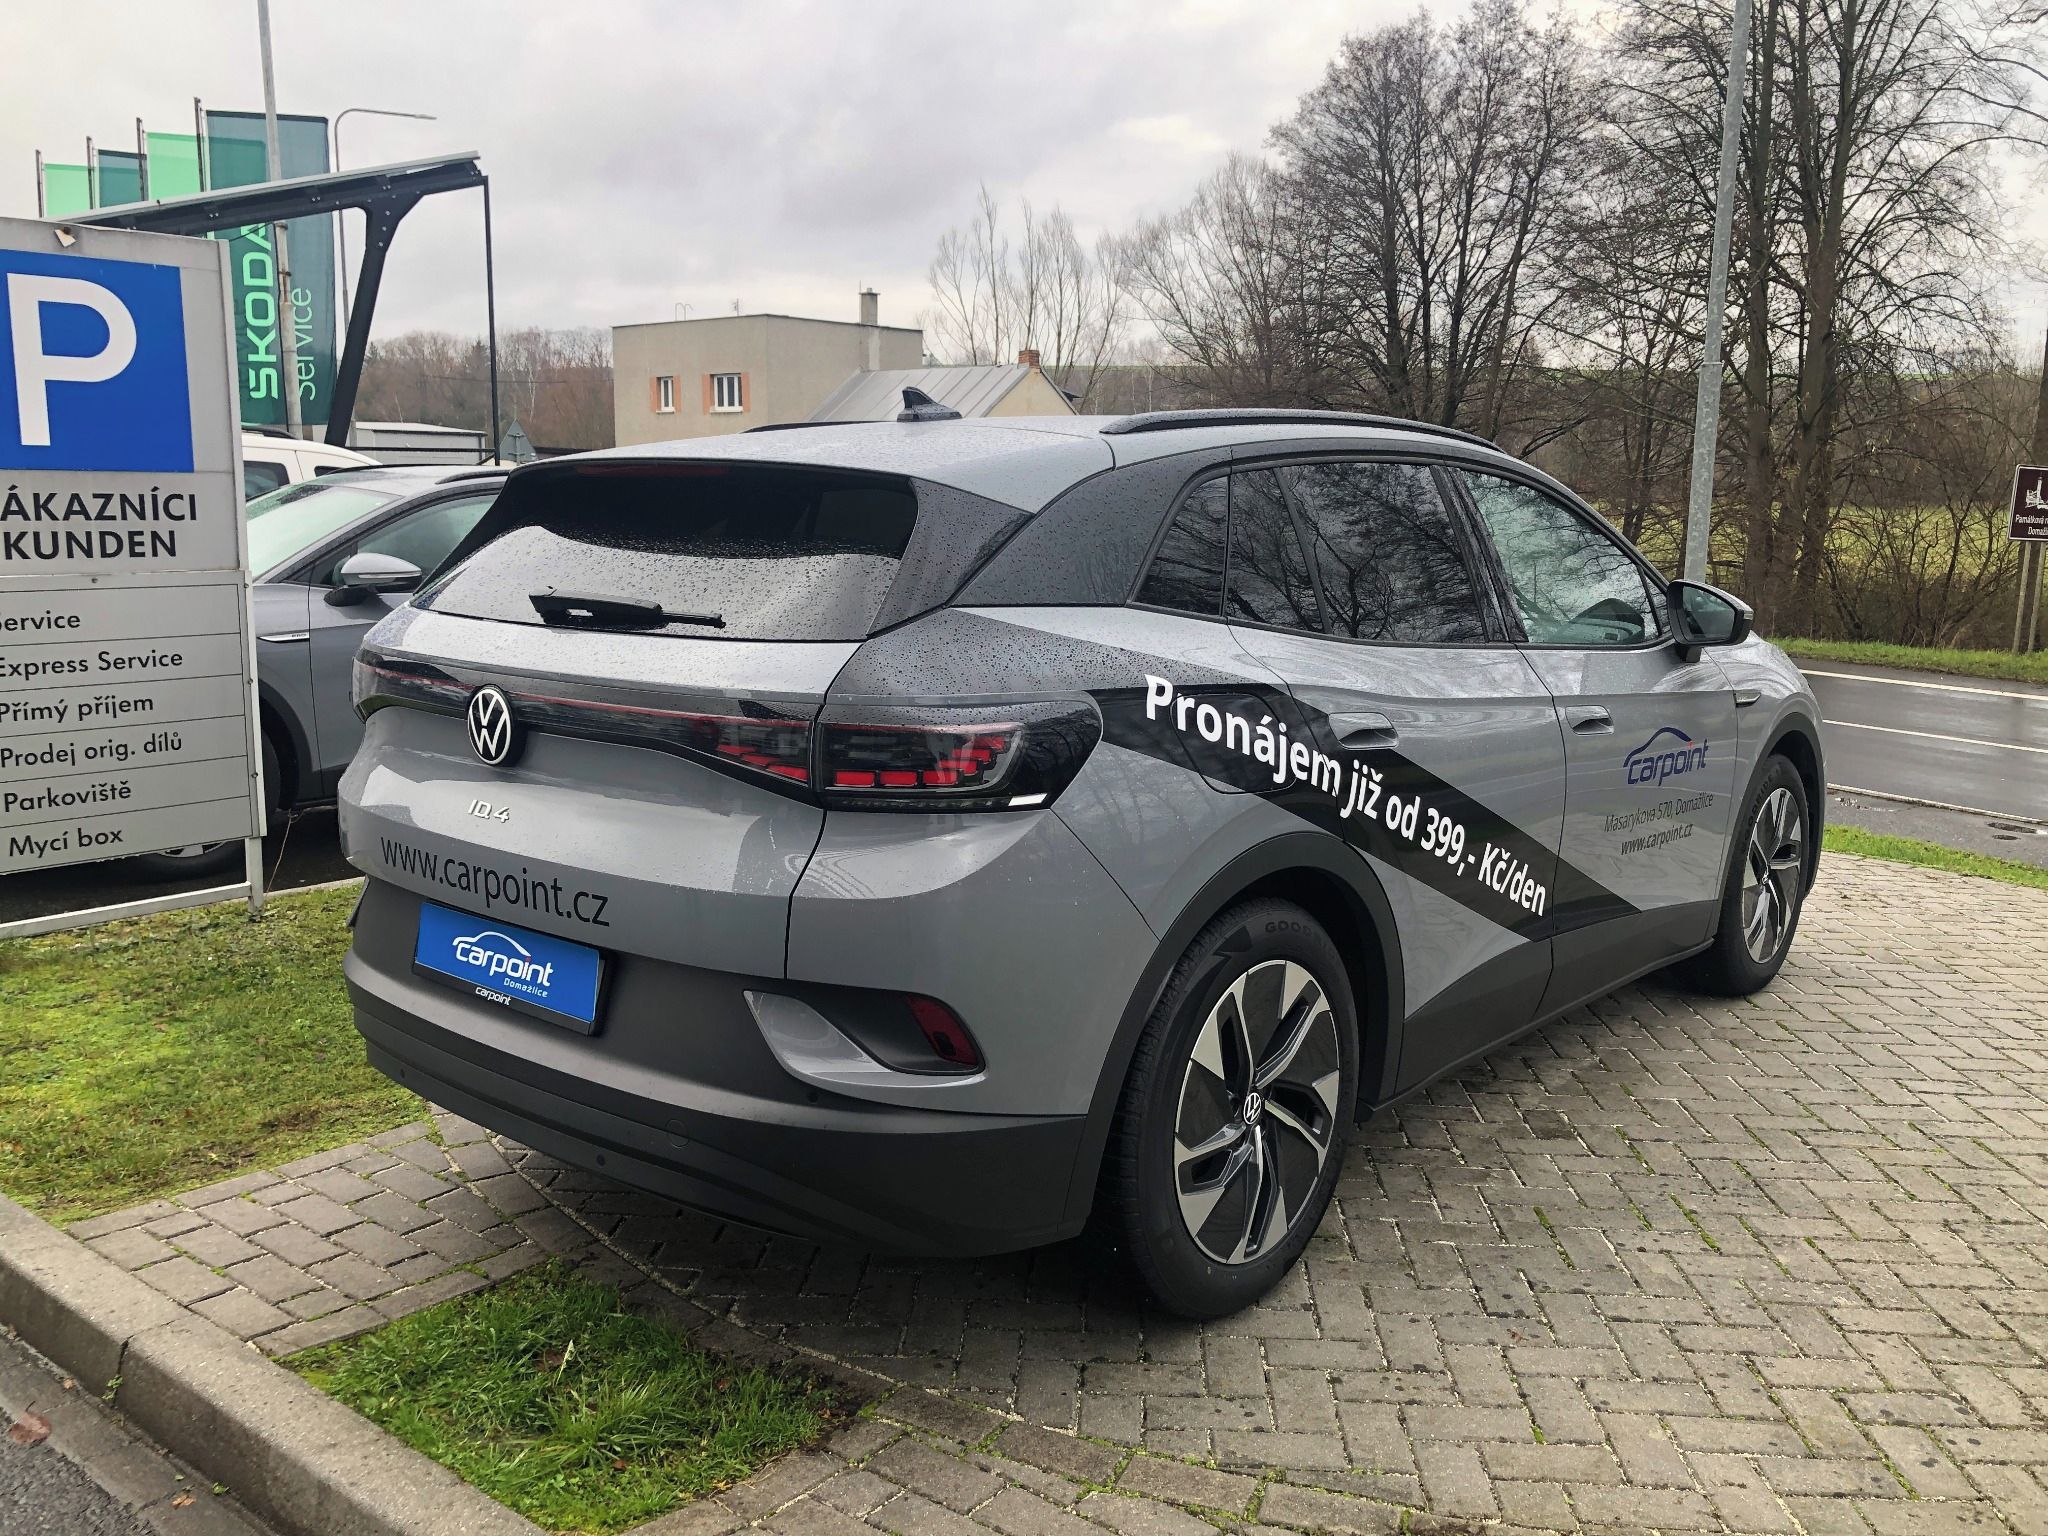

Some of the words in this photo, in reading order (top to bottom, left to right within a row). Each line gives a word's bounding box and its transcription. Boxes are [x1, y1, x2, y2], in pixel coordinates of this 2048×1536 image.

[7, 273, 137, 446] P
[3, 530, 177, 560] KUNDEN
[0, 610, 81, 631] ervice
[0, 655, 89, 681] Express
[97, 650, 183, 672] Service
[0, 699, 68, 723] Přímý
[78, 695, 154, 721] příjem
[1, 742, 76, 767] Prodej
[84, 739, 136, 761] orig.
[143, 732, 182, 754] dílů
[1627, 738, 1709, 787] carpoint
[4, 780, 132, 812] Parkoviště
[1144, 673, 1341, 797] Pronájem
[1340, 759, 1384, 819] již
[1385, 796, 1421, 841] od
[1421, 808, 1476, 877] 399,-
[1478, 842, 1547, 917] Kč/den
[1604, 807, 1656, 833] Masarykova
[1656, 800, 1674, 820] 570,
[1675, 791, 1714, 815] Domažlice
[9, 831, 69, 858] Mycí
[78, 828, 123, 847] box
[1621, 823, 1694, 856] www.carpoint.cz
[381, 837, 611, 927] www.carpoint.cz
[455, 942, 554, 987] carpoint
[475, 986, 512, 1006] carpoint
[503, 977, 549, 998] Domažlice
